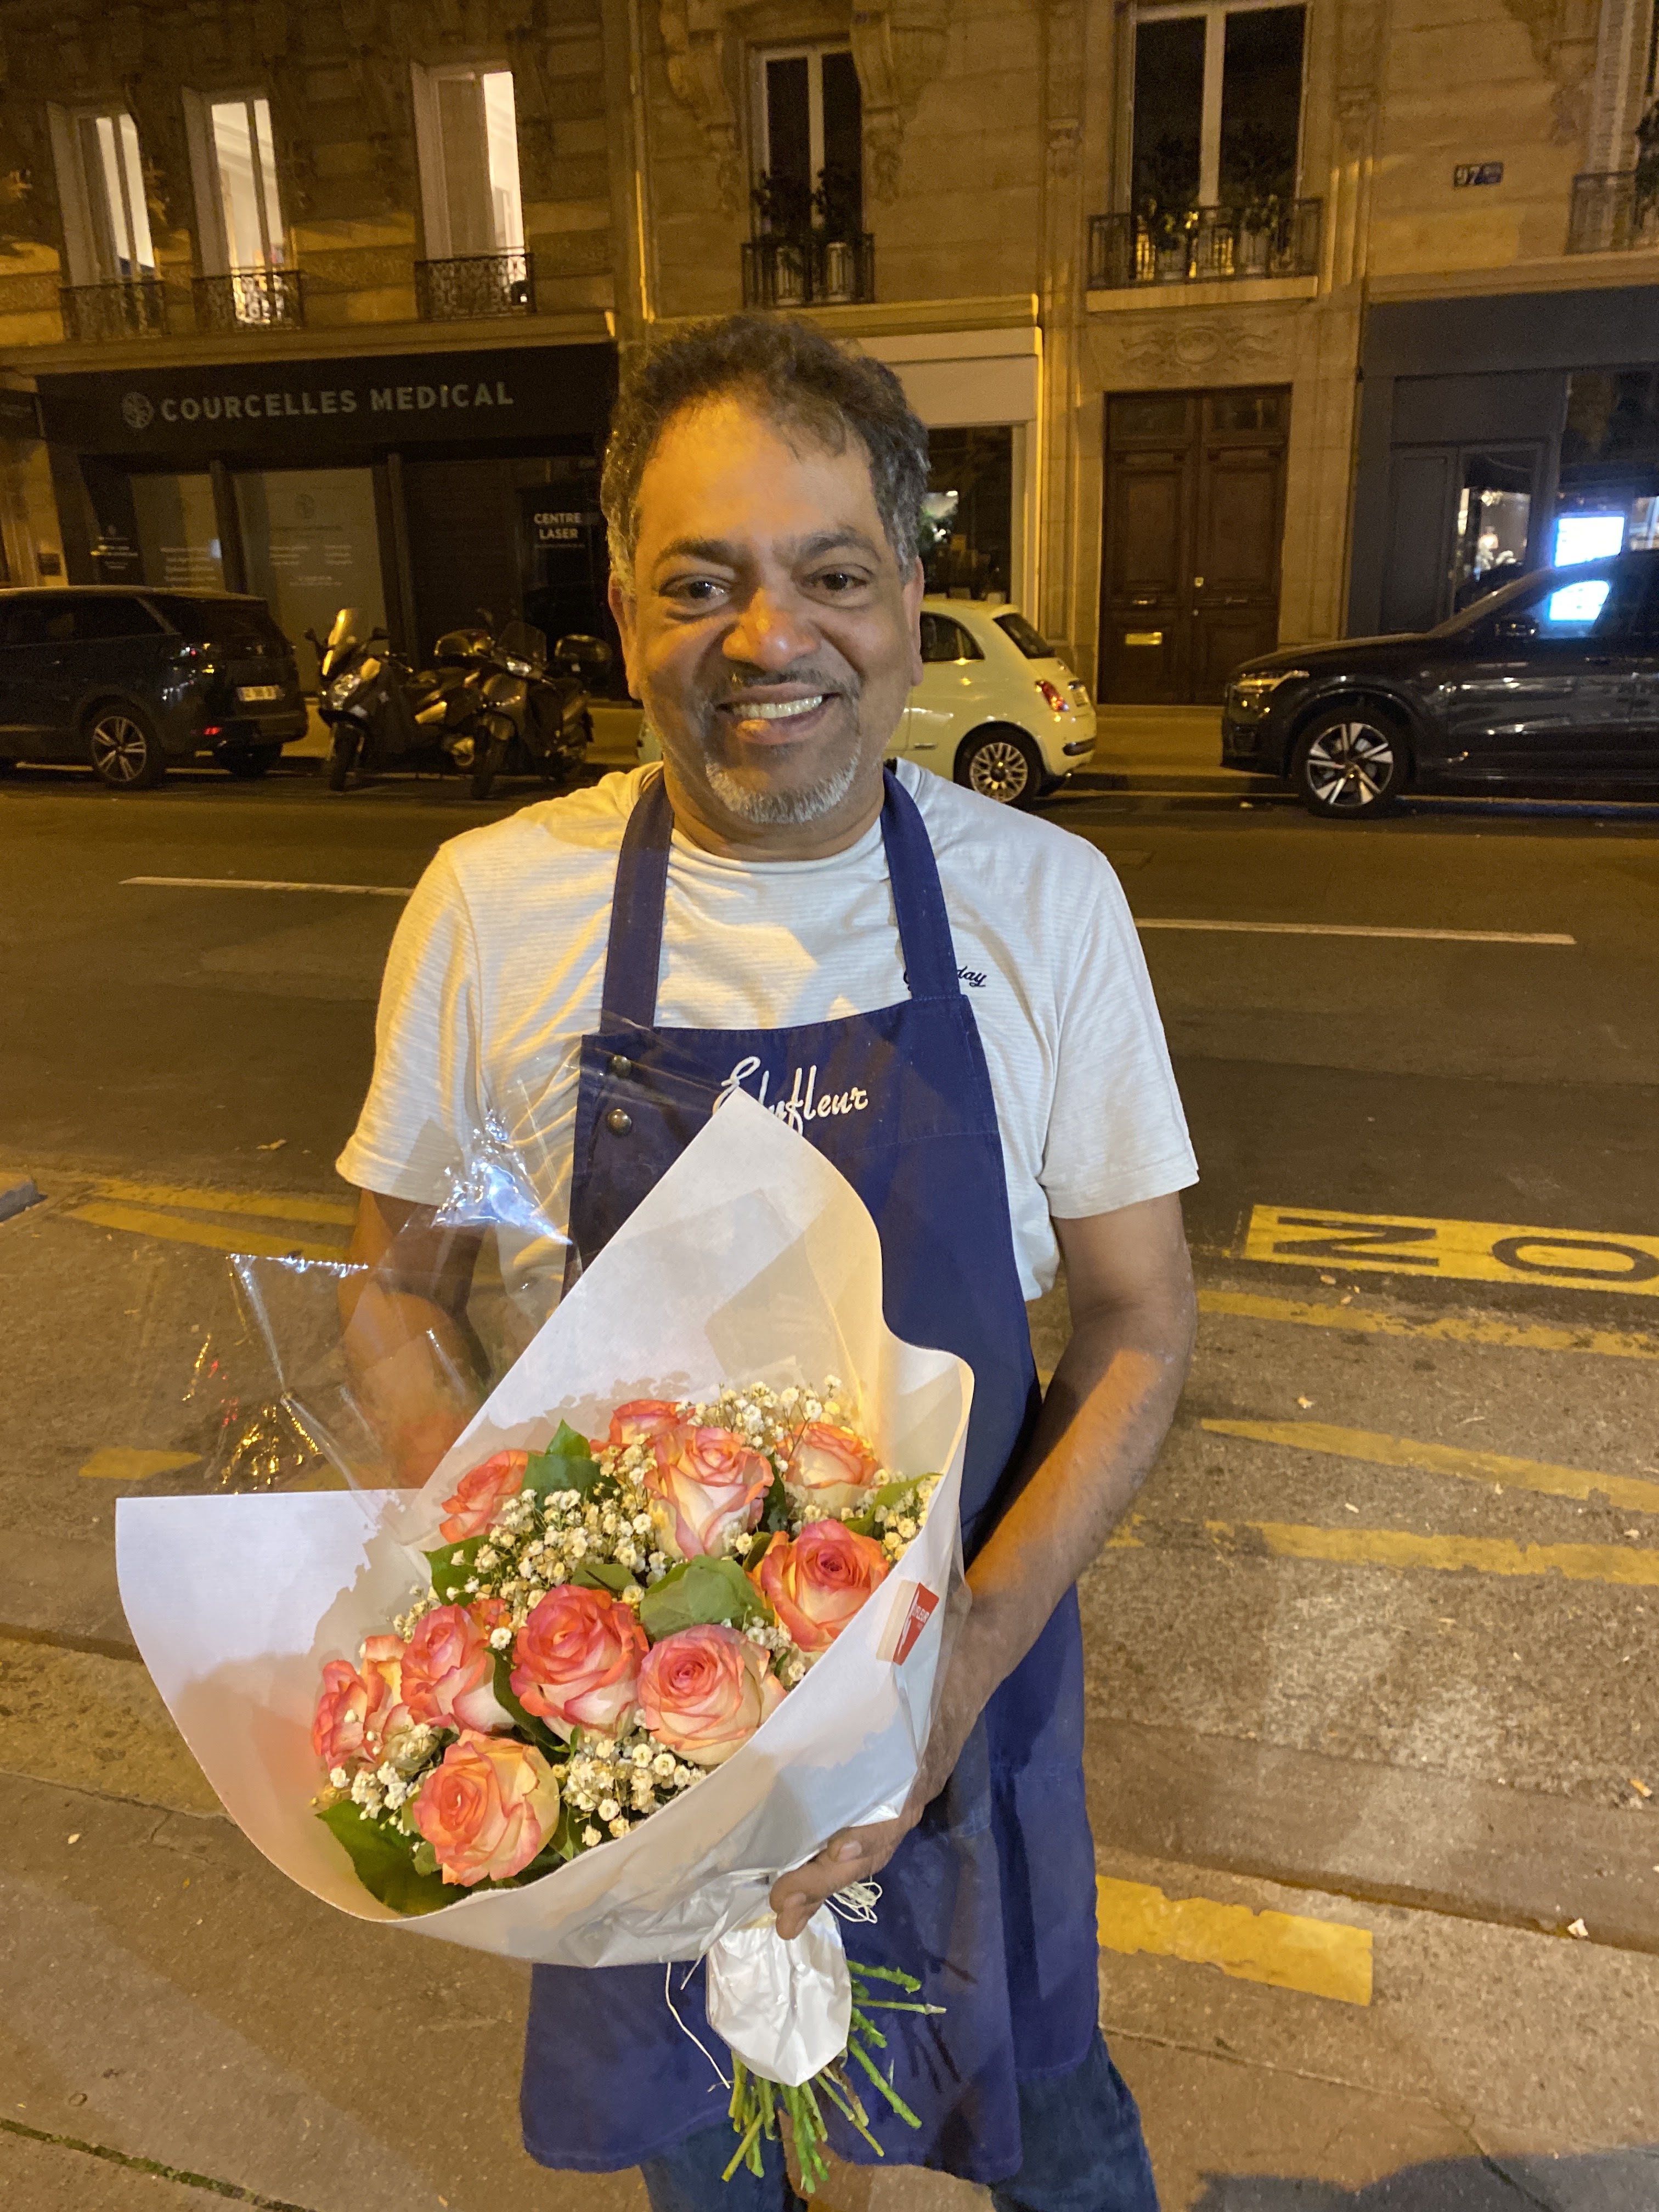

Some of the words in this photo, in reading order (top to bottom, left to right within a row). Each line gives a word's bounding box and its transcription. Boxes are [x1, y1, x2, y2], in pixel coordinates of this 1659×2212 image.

[161, 389, 357, 422] COURCELLES
[370, 382, 514, 411] MEDICAL
[534, 512, 582, 524] CENTRE
[539, 528, 578, 539] LASER
